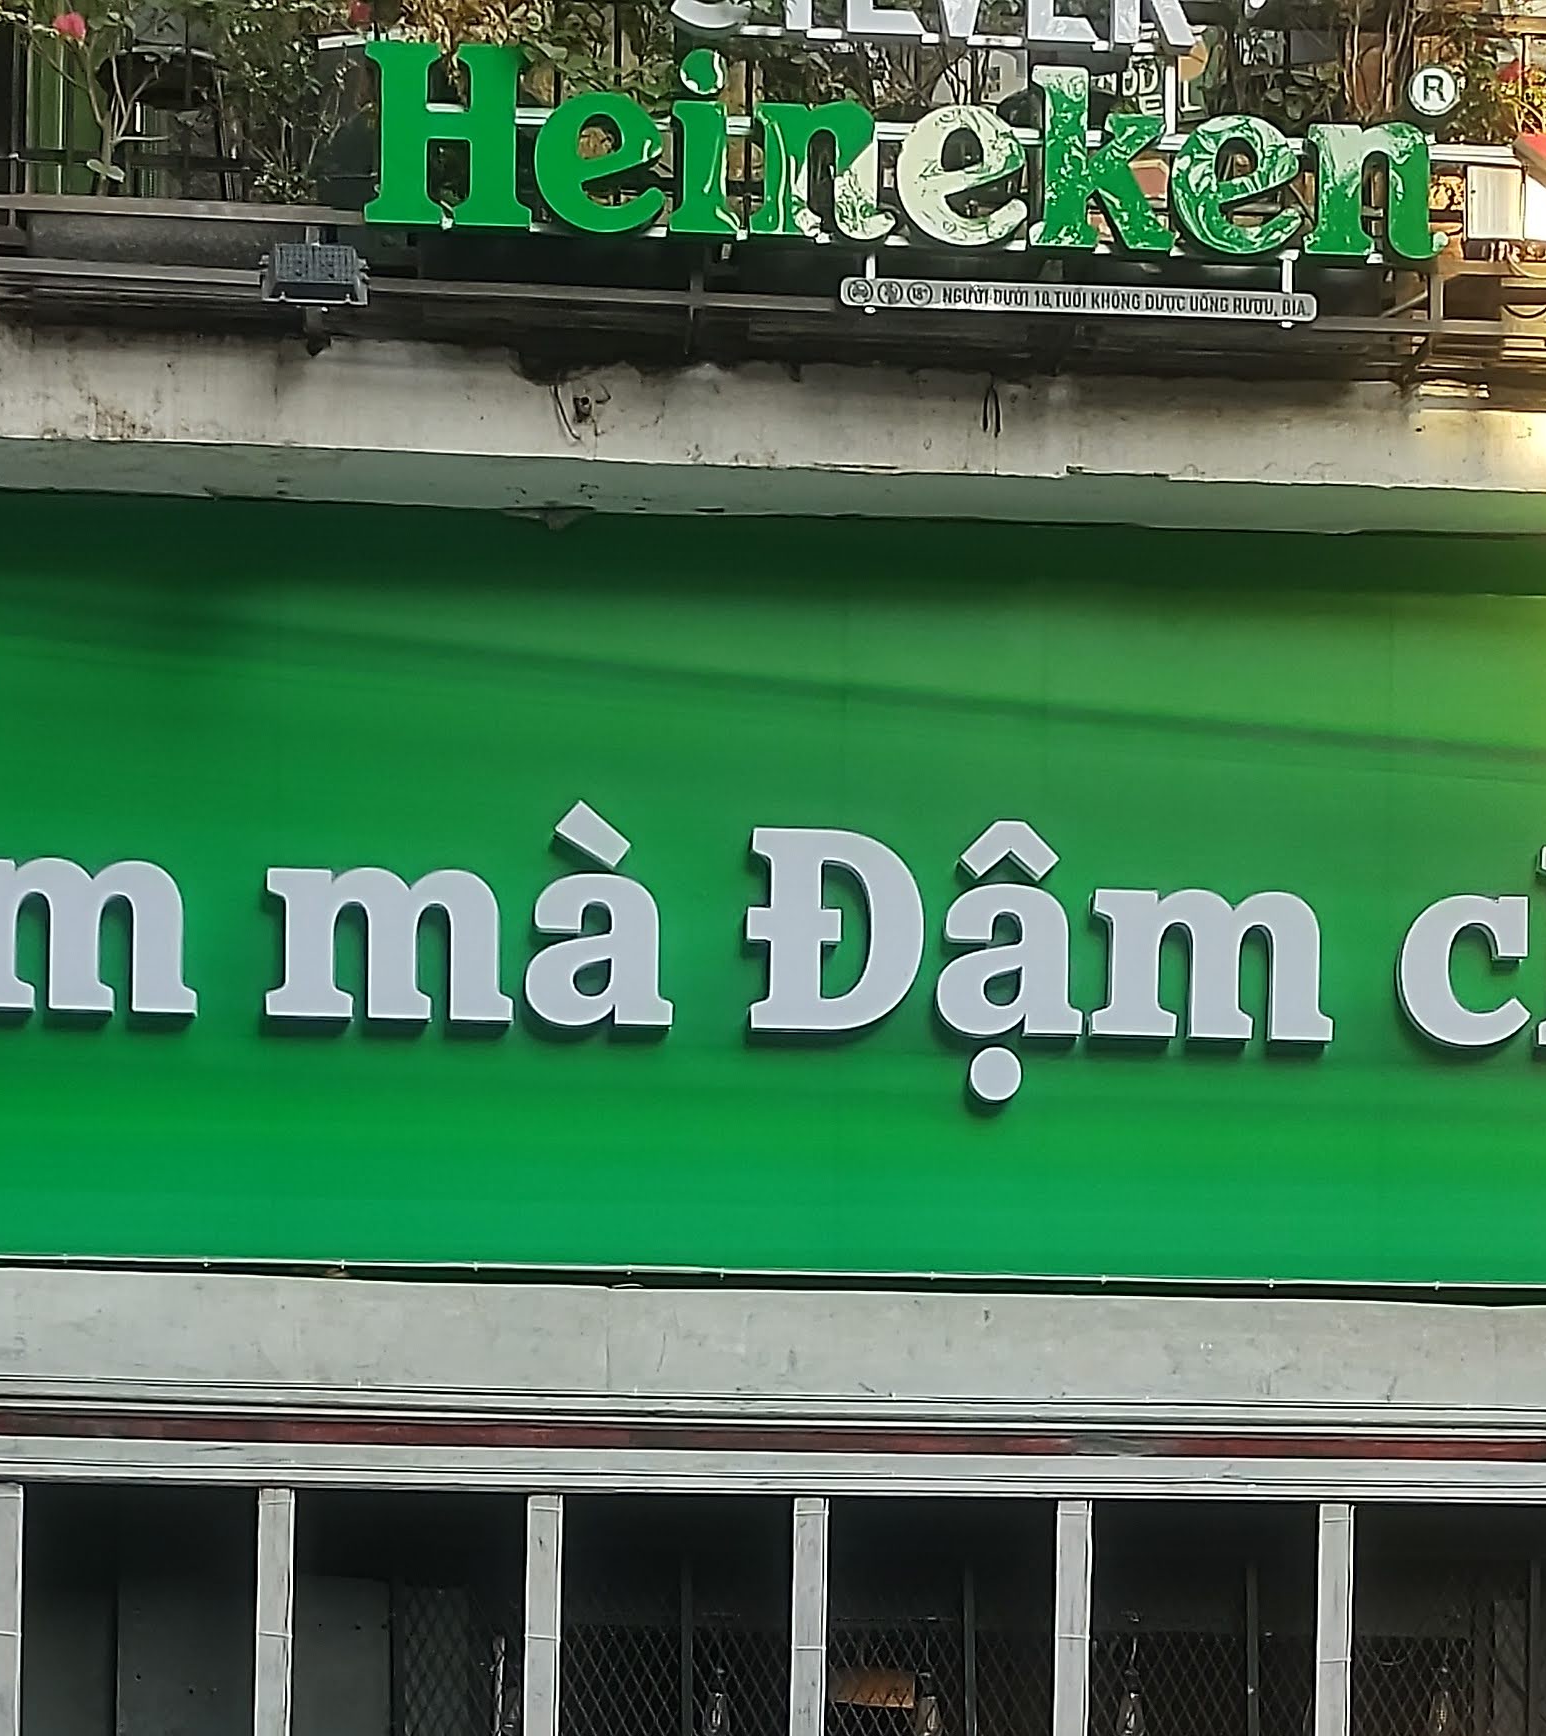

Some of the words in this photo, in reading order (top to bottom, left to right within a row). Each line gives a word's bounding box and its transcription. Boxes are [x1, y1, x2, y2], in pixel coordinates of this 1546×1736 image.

[363, 38, 1447, 262] Heineken
[264, 799, 675, 1031] mà
[744, 818, 1335, 1106] Đậm
